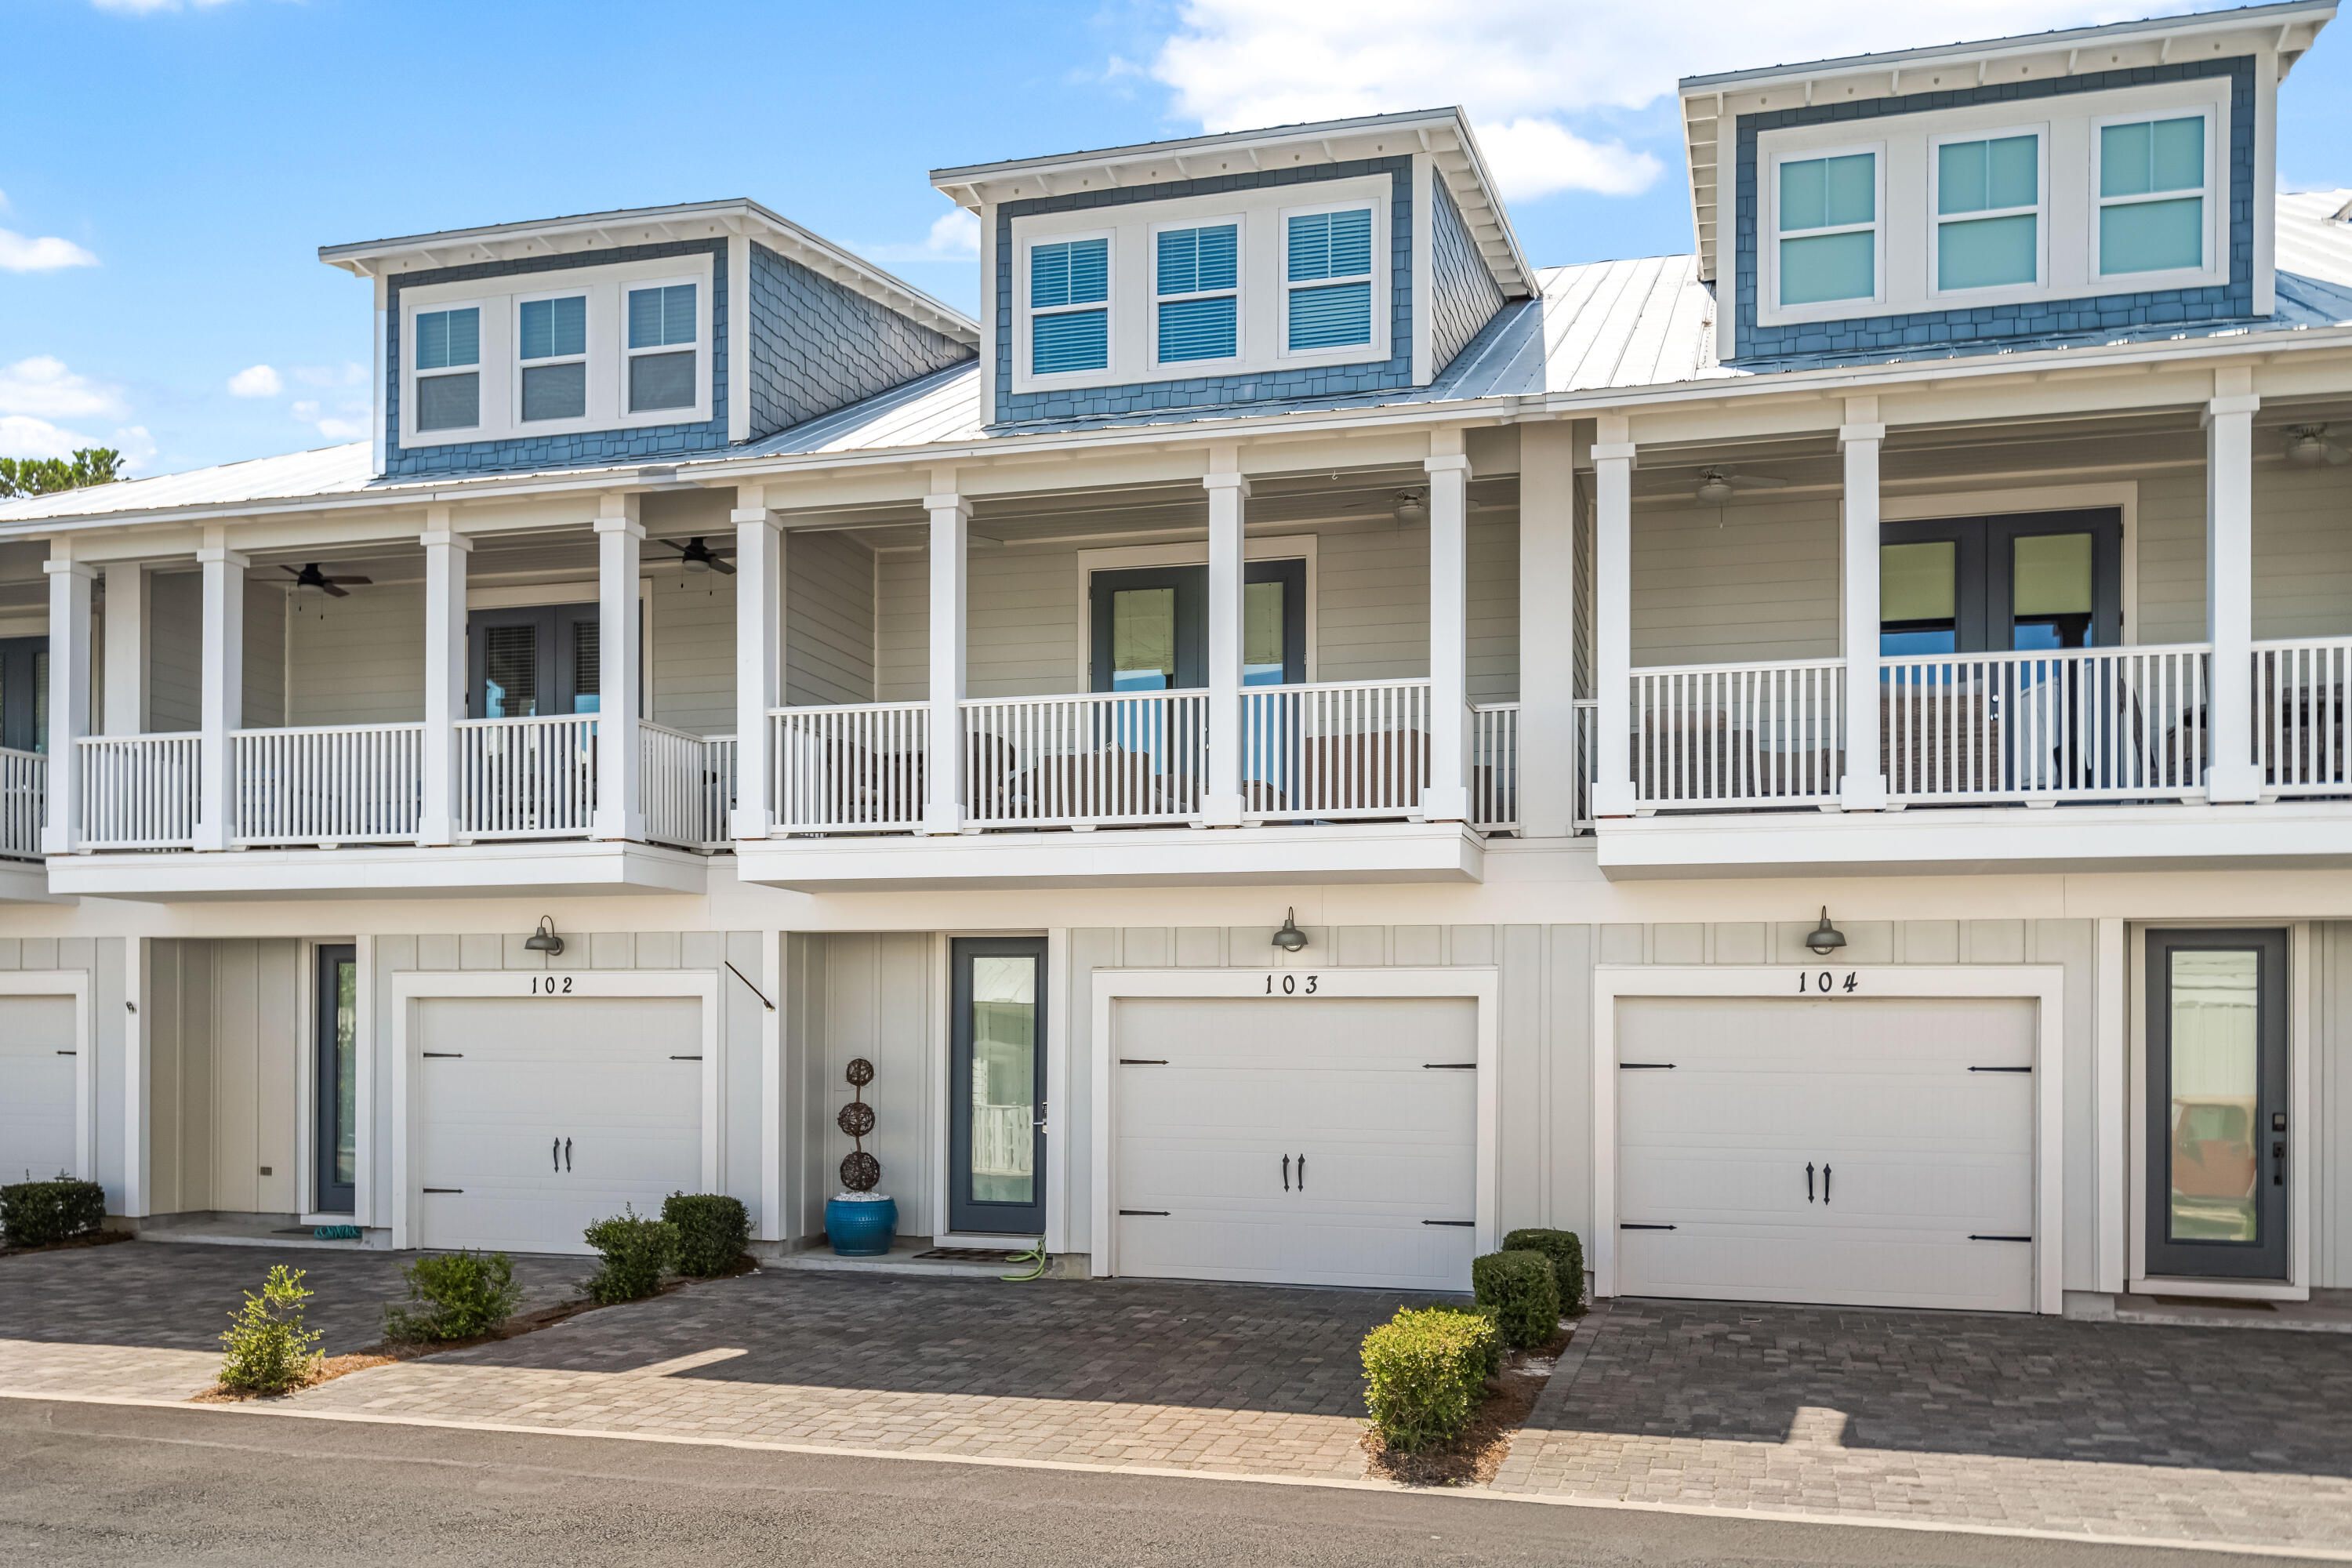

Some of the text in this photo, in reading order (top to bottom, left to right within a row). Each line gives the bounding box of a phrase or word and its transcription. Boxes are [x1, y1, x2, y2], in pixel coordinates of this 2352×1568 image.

[532, 976, 572, 995] 102
[1265, 975, 1319, 995] 103
[1798, 971, 1859, 994] 104
